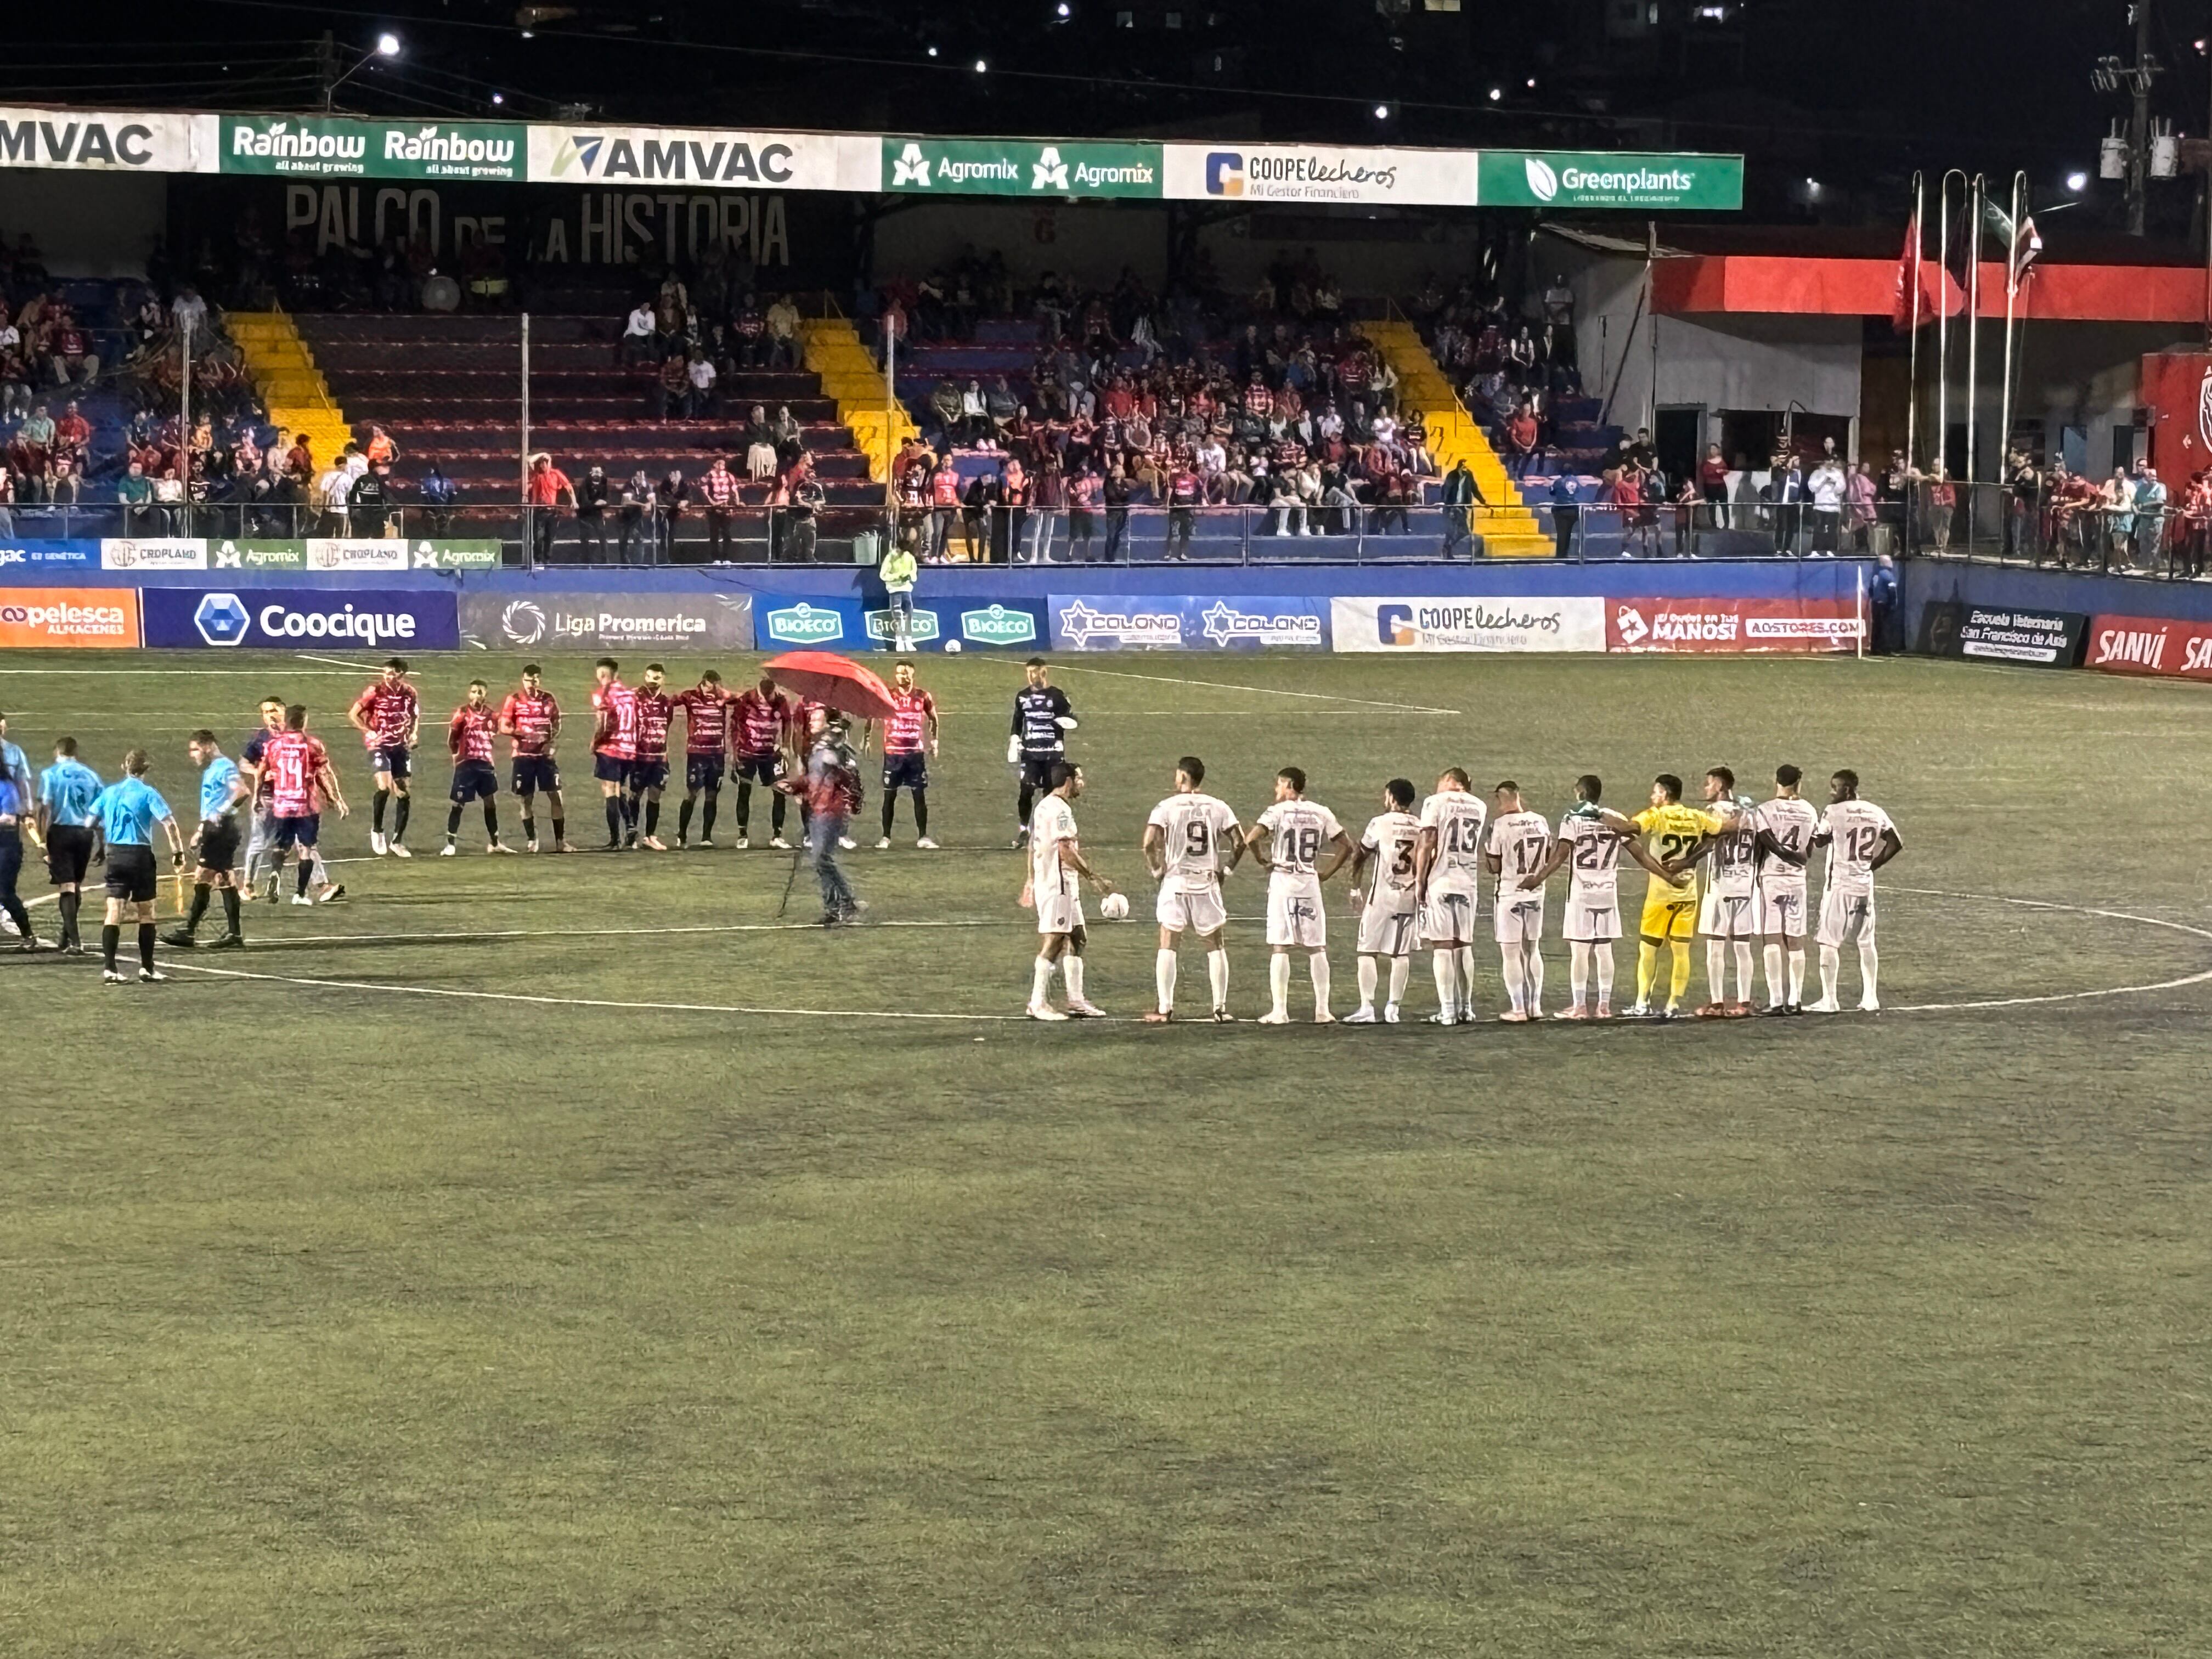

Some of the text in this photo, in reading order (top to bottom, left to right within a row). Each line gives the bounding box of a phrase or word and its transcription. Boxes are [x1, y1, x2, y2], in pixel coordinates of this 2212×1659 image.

[233, 122, 365, 158] Rainbow
[385, 126, 515, 161] Rainbow
[603, 138, 793, 183] AMVAC
[938, 157, 1019, 183] Agromix
[1074, 162, 1153, 187] Agromix
[1267, 184, 1301, 198] Gestor
[1562, 167, 1691, 194] Greenplants
[581, 193, 789, 266] HISTORIA
[246, 548, 300, 566] Agromix
[442, 549, 496, 566] Agromix
[259, 603, 416, 646] Coocique
[555, 612, 706, 636] Liga Promerica
[1091, 617, 1178, 630] COLONO
[1652, 623, 1737, 641] MANOS!
[2180, 637, 2212, 672] SA
[276, 758, 303, 789] 14
[1186, 820, 1208, 857] 9
[1284, 828, 1320, 863] 18
[1447, 816, 1481, 854] 13
[1575, 833, 1619, 870] 27
[1846, 826, 1877, 861] 12
[1392, 839, 1415, 876] 3
[1514, 837, 1545, 874] 17
